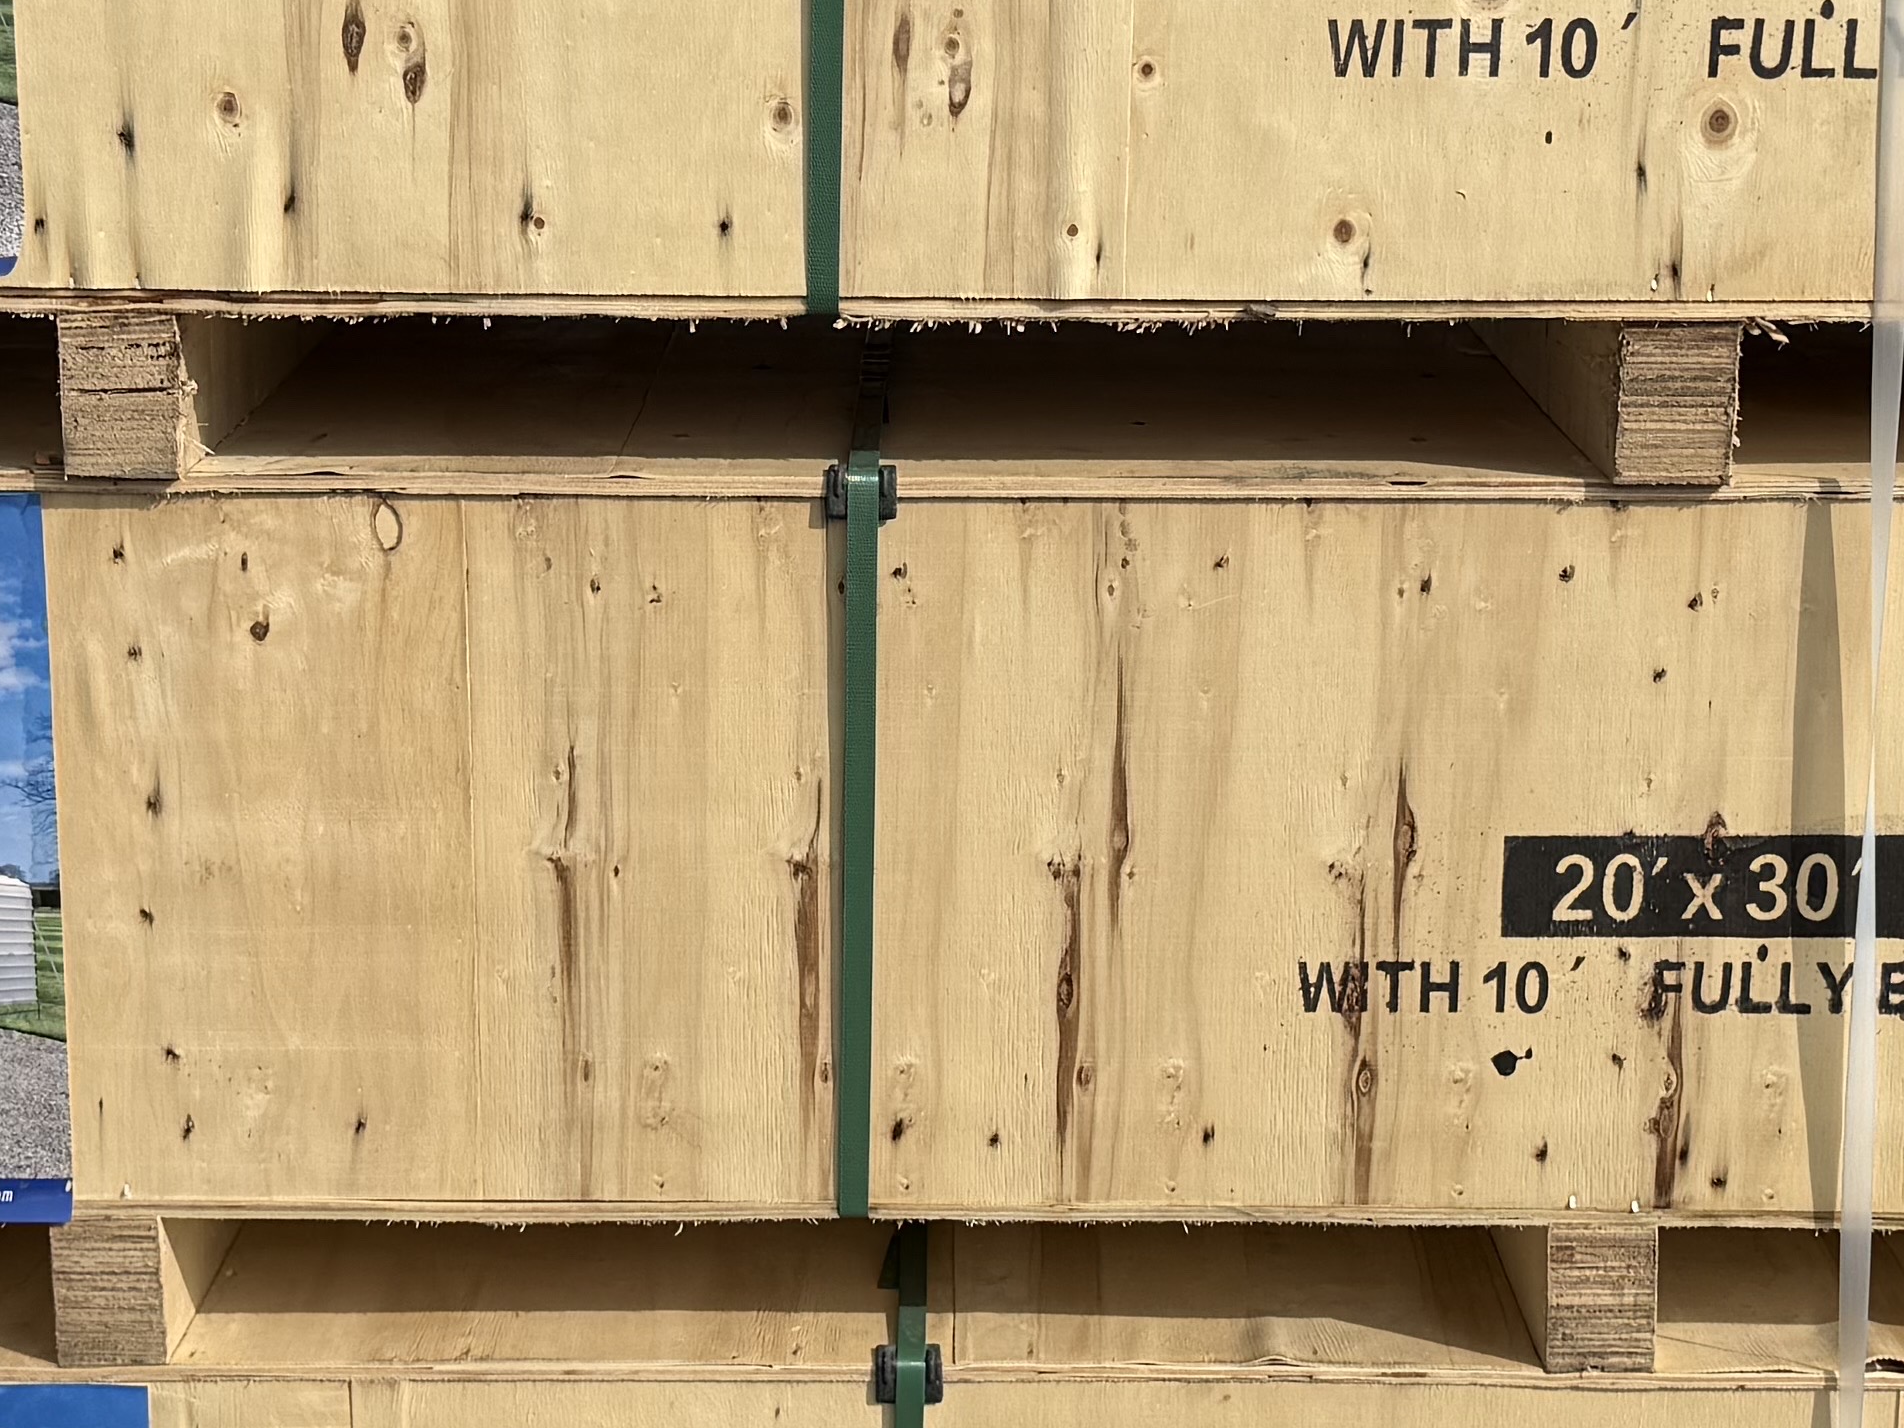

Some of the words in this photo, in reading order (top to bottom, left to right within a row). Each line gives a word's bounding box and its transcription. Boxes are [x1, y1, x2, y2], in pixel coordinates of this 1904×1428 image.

[1327, 18, 1505, 79] WITH
[1680, 873, 1724, 920] x
[1298, 961, 1460, 1014] WITH
[1652, 961, 1855, 1015] FULLY
